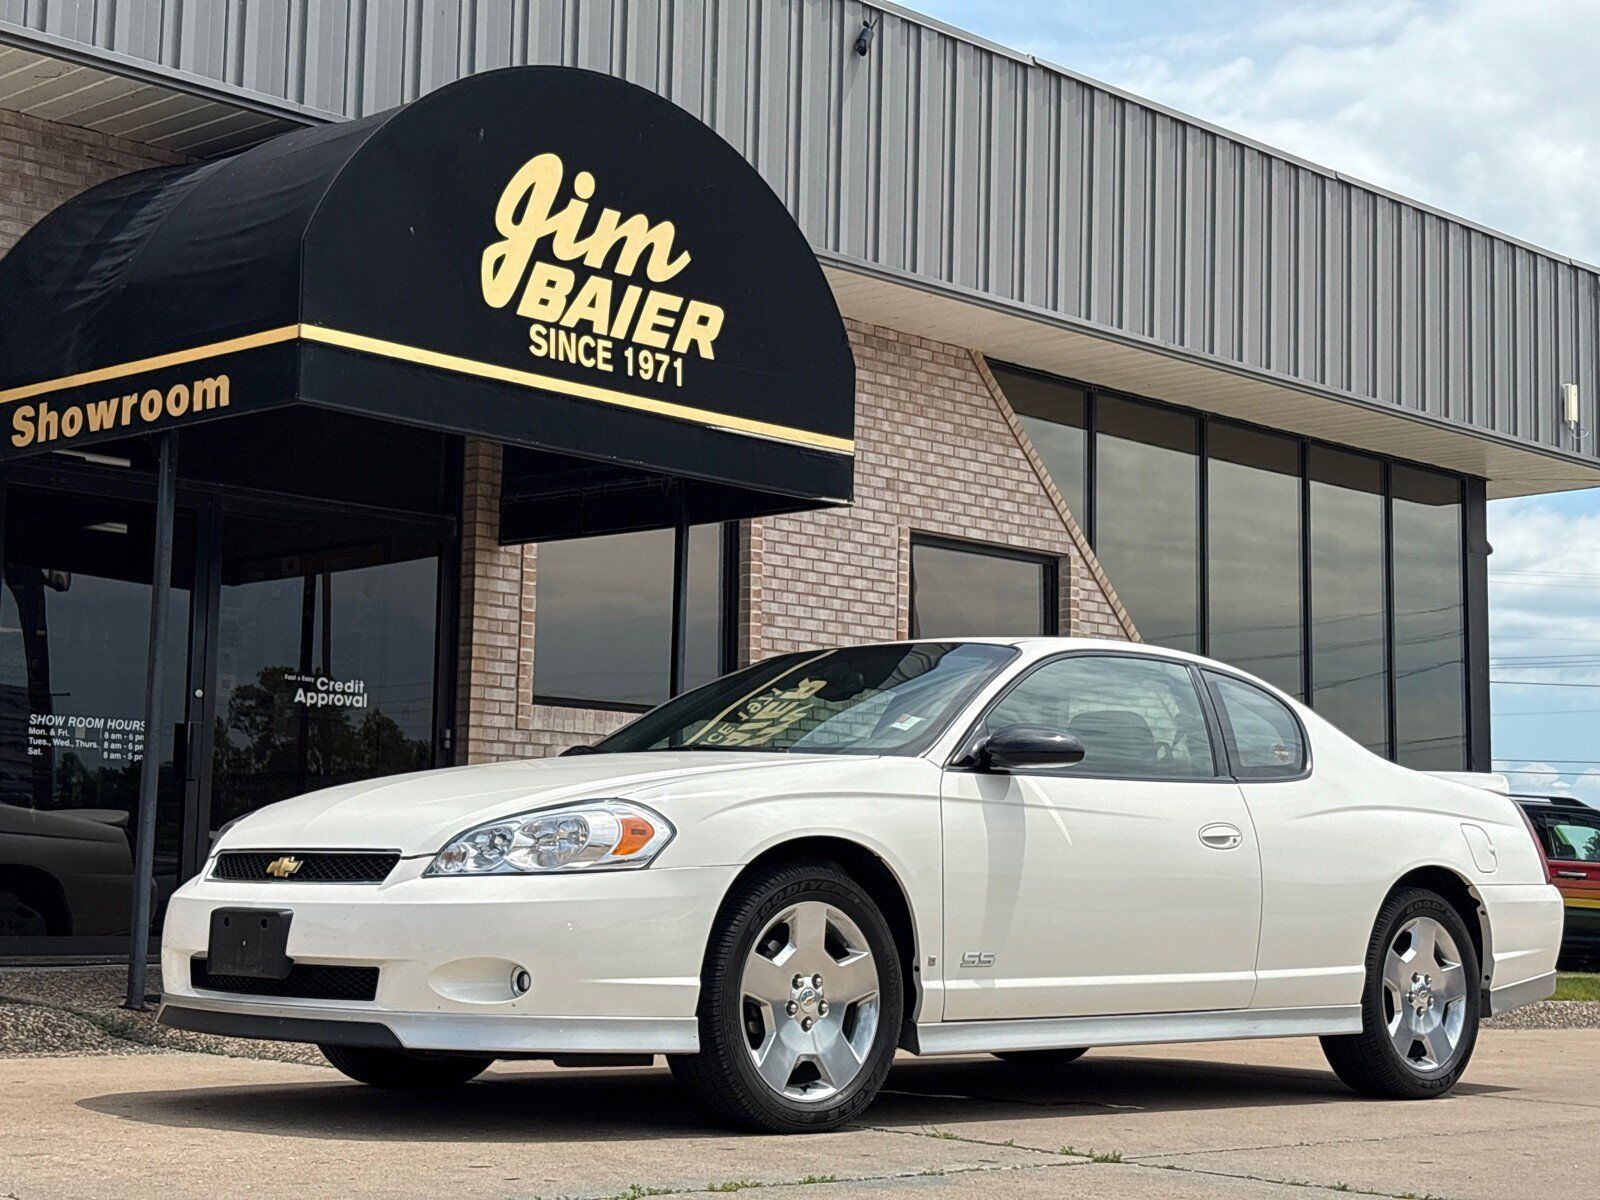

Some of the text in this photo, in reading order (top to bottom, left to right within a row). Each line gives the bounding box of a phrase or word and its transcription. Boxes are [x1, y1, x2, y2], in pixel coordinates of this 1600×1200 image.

[515, 260, 725, 360] BAIER
[528, 323, 683, 388] SINCE 1971
[11, 374, 230, 448] Showroom
[316, 676, 364, 693] Credit
[293, 687, 368, 708] Approval
[29, 713, 66, 727] SHOW
[67, 716, 104, 729] ROOM
[28, 726, 48, 736] Mon.
[49, 728, 56, 736] &
[57, 728, 70, 737] Fri.
[104, 731, 109, 739] 8
[110, 732, 122, 740] am
[128, 732, 134, 740] 6
[27, 747, 43, 756] Sat.
[103, 751, 108, 759] 8
[109, 752, 122, 760] am
[75, 739, 100, 749] Thurs.
[103, 741, 109, 749] 8
[110, 742, 122, 750] am
[128, 742, 133, 751] 6
[960, 951, 996, 968] SS
